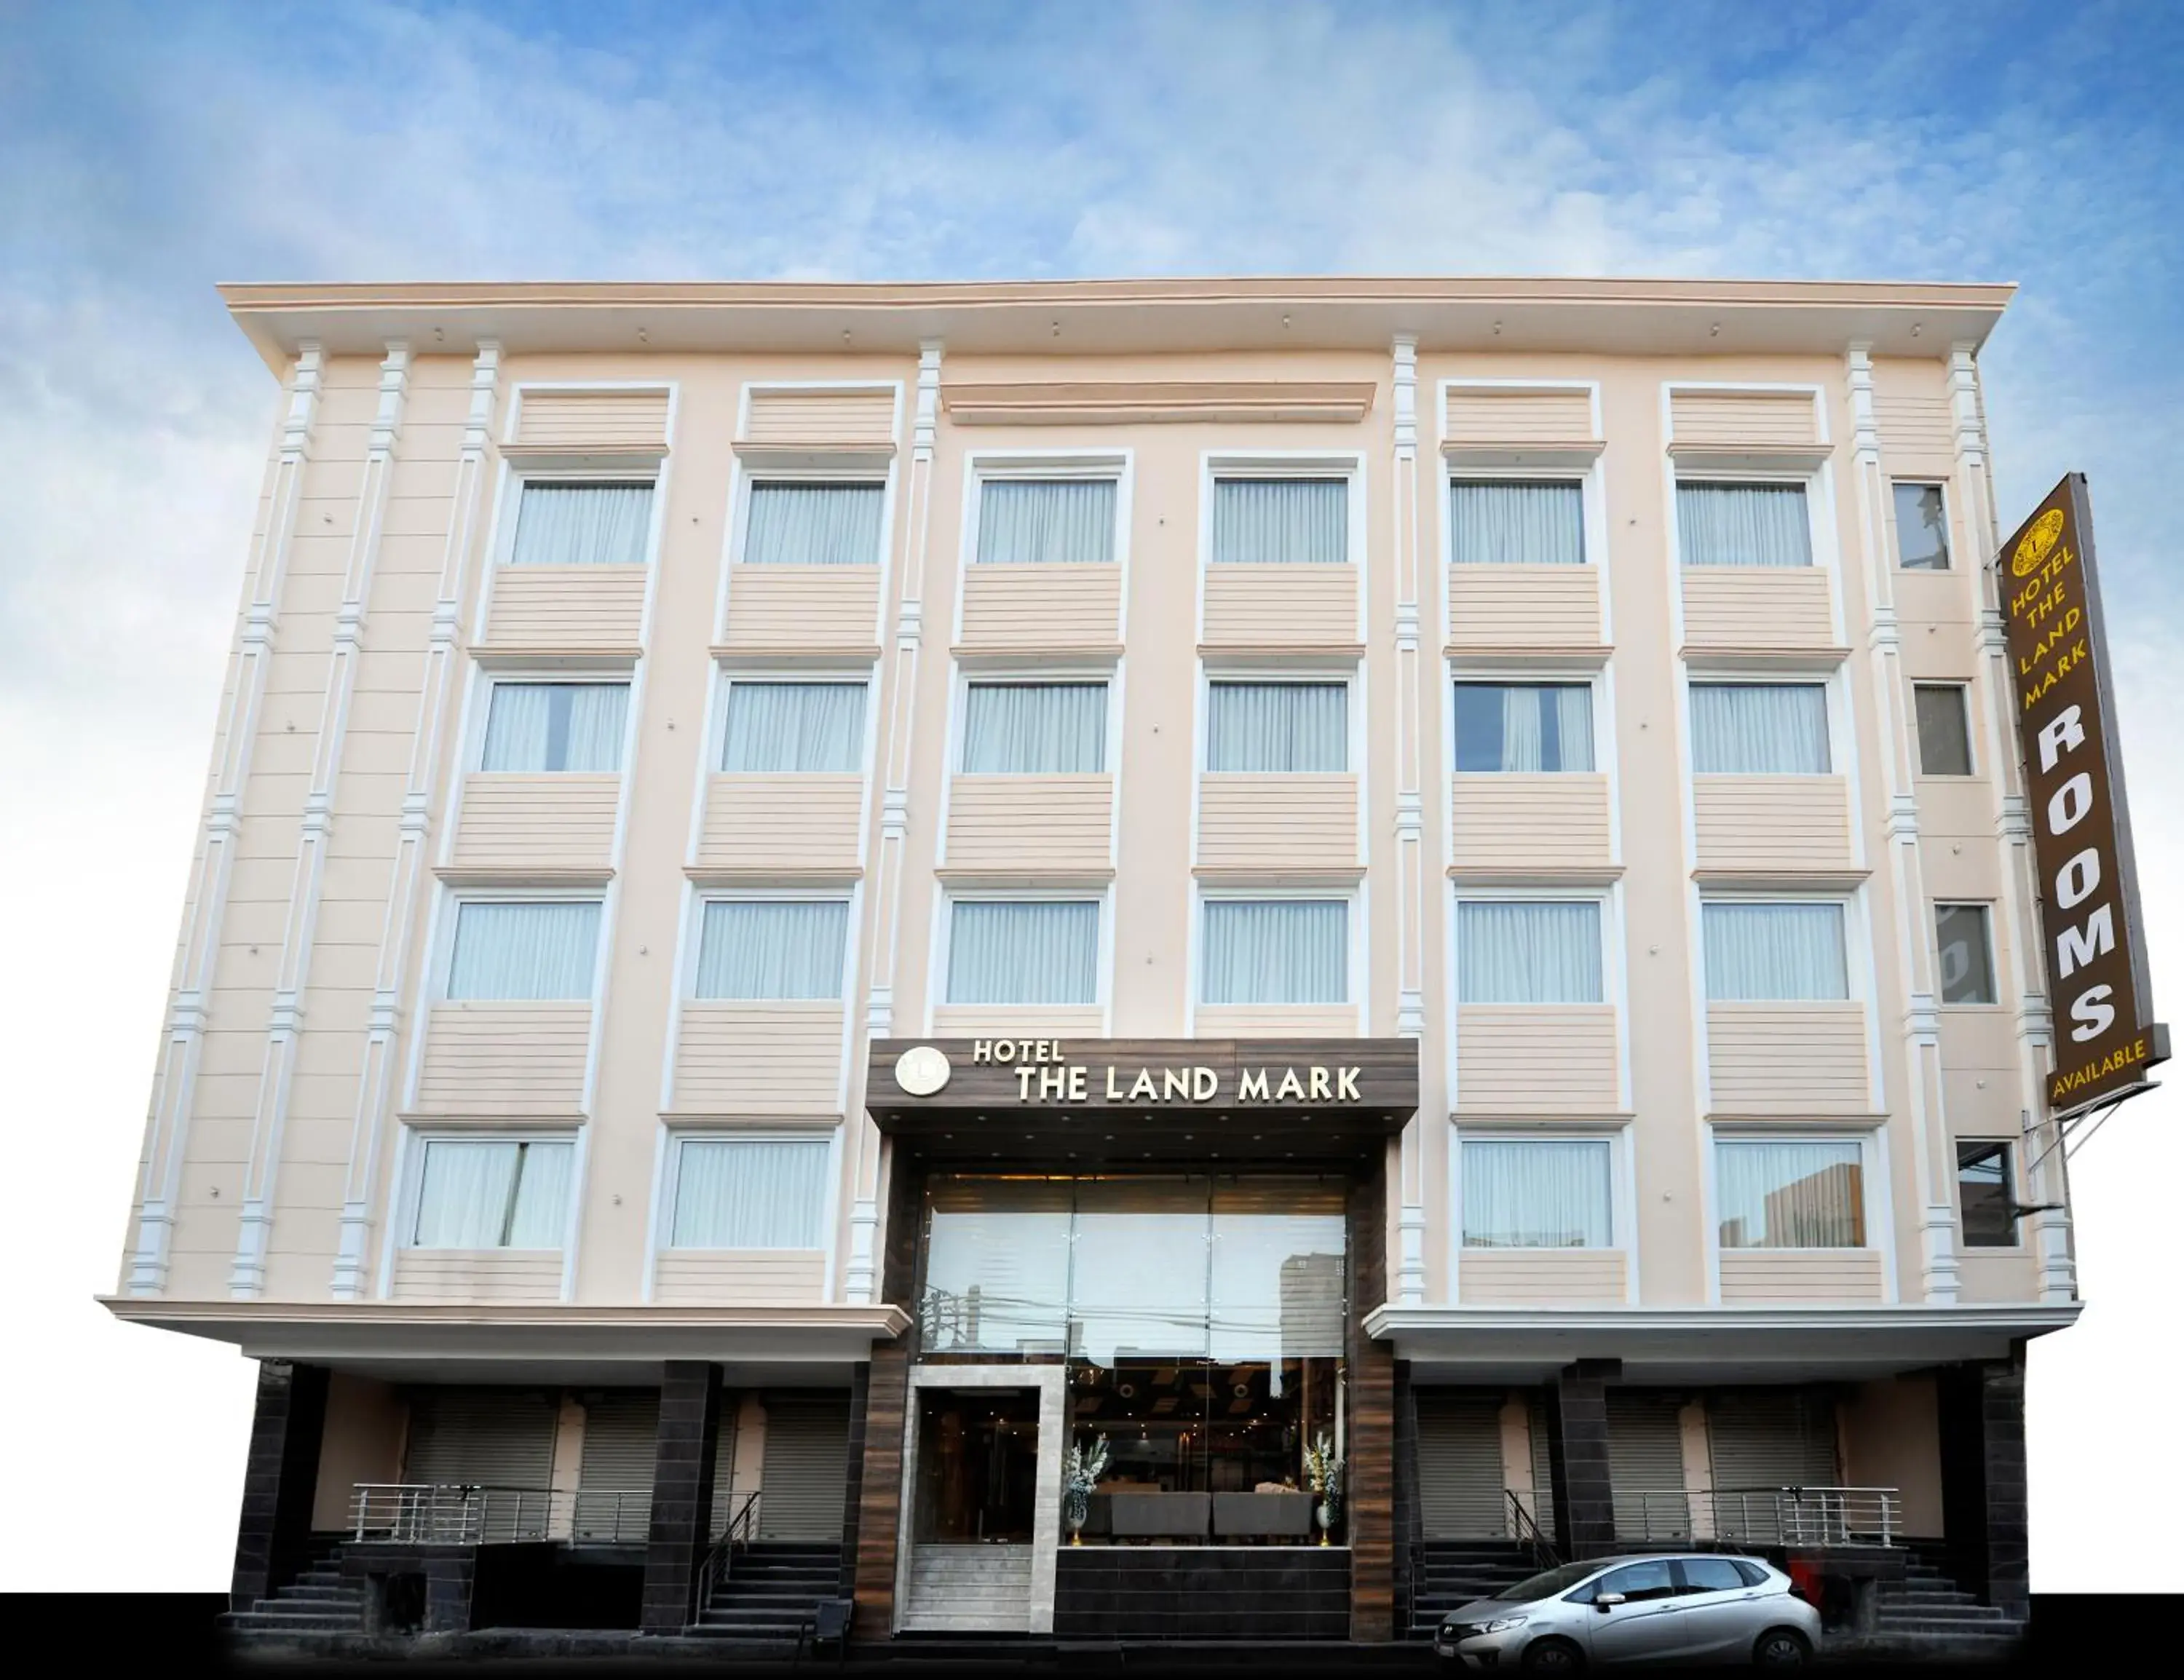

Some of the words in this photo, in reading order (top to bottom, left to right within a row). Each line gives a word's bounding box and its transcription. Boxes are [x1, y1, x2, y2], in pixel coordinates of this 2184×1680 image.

[2011, 545, 2074, 617] HOTEL
[2026, 580, 2066, 630] THE
[2020, 606, 2081, 675] LAND
[2025, 638, 2086, 709] MARK
[2038, 704, 2116, 1042] ROOMS
[973, 1039, 1065, 1063] HOTEL
[2052, 1039, 2146, 1097] AVAILABLE
[1014, 1066, 1088, 1101] THE
[1106, 1066, 1219, 1101] LAND
[1238, 1066, 1361, 1101] MARK
